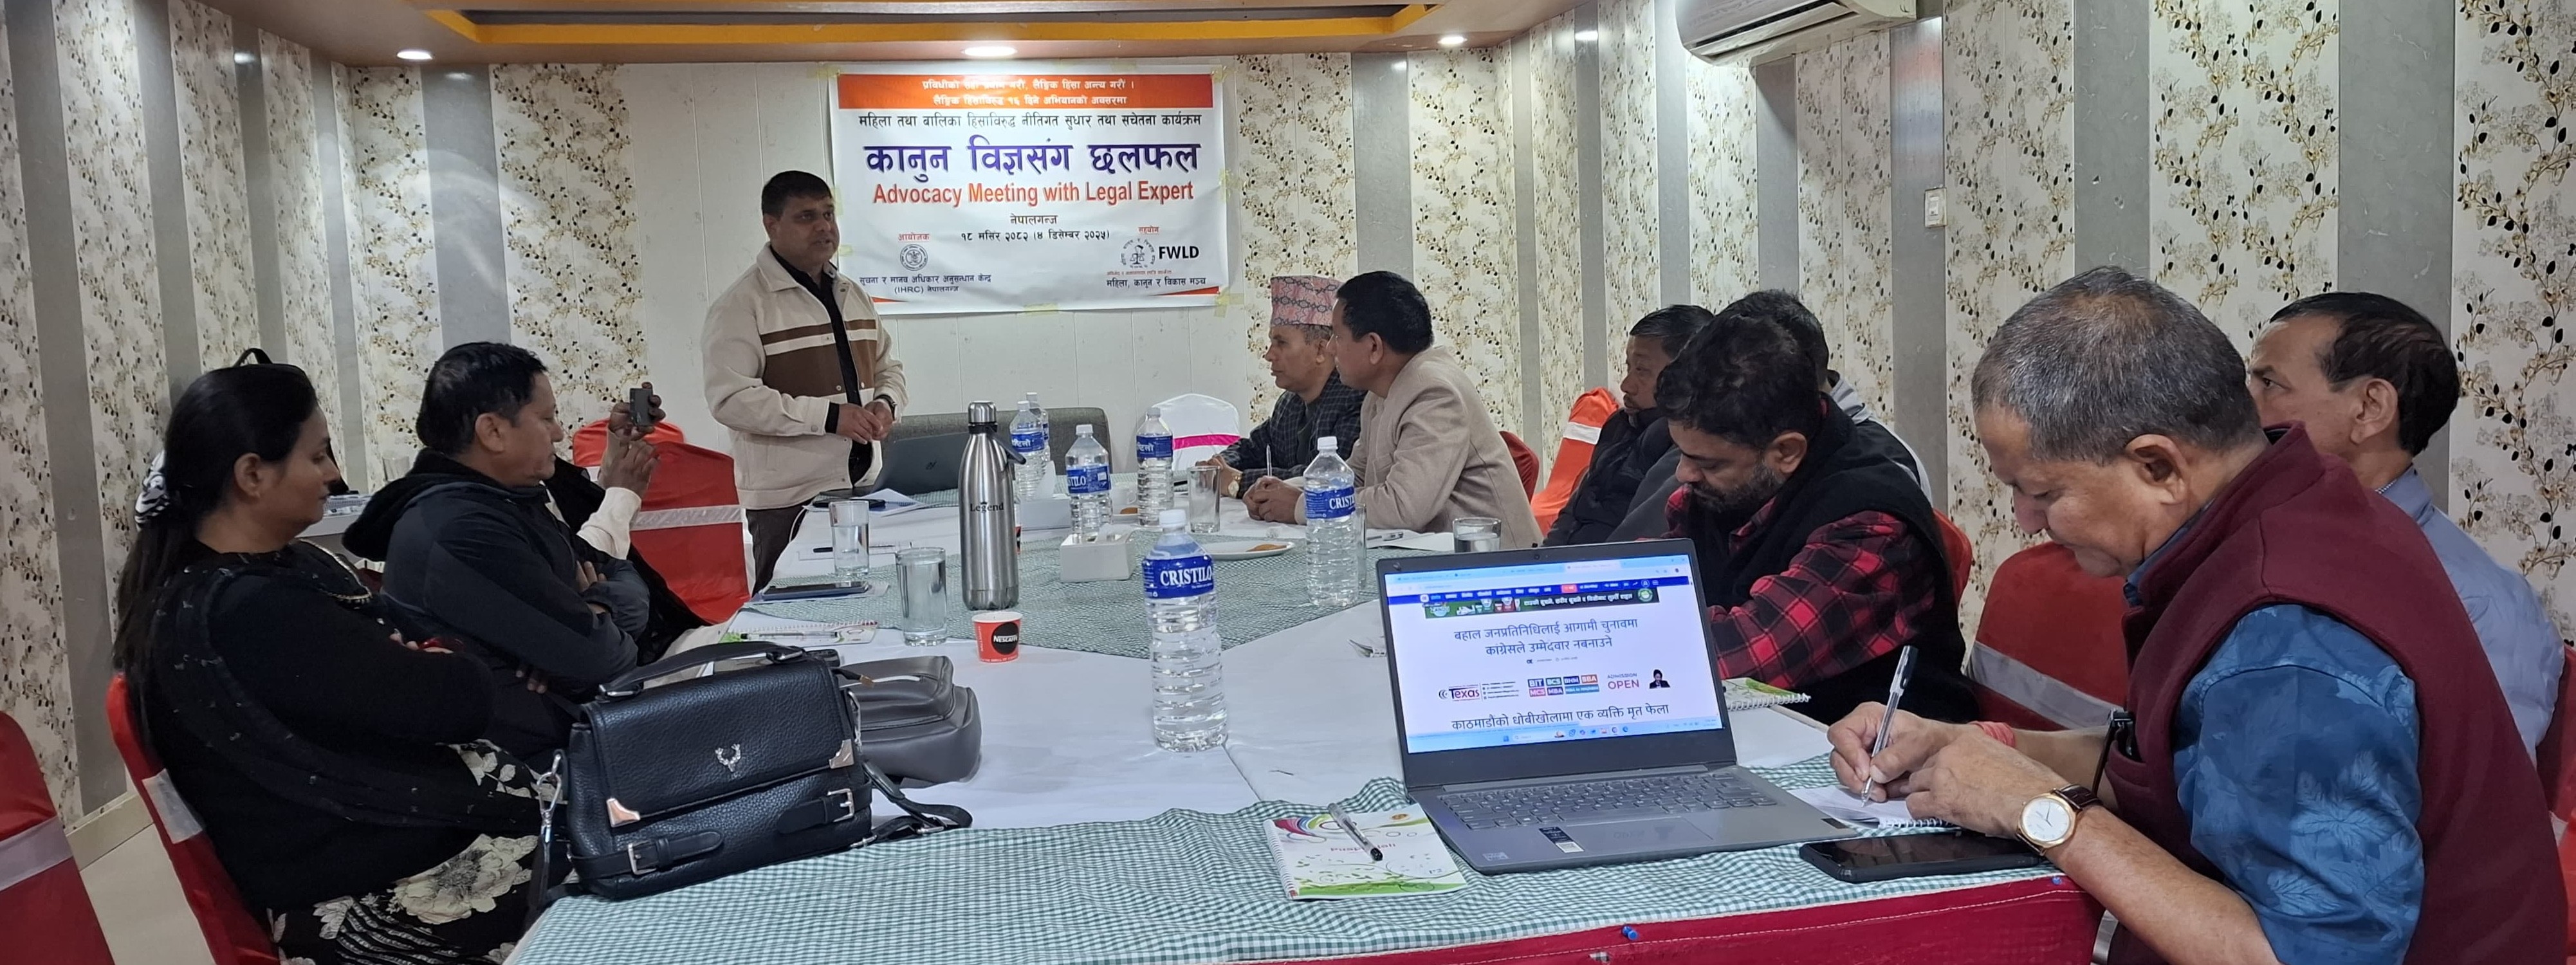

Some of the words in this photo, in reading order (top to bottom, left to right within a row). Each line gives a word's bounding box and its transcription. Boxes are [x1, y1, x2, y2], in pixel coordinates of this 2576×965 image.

[859, 112, 892, 129] महिला
[897, 116, 917, 127] तथा
[923, 112, 962, 128] बालिका
[1022, 111, 1059, 127] नीतिगत
[1065, 115, 1092, 130] सुधार
[1098, 115, 1116, 126] तथा
[1121, 112, 1156, 126] सचेतना
[1161, 111, 1202, 126] कार्यक्रम
[863, 146, 952, 183] कानुन
[966, 134, 1073, 175] विज्ञसंग
[1087, 143, 1201, 174] छलफल
[872, 183, 962, 208] Advocacy
[968, 183, 1038, 207] Meeting
[1043, 181, 1080, 202] with
[1086, 181, 1132, 205] Legal
[1138, 180, 1194, 205] Expert
[1010, 214, 1058, 225] नेपालगन्ज
[961, 232, 973, 241] १८
[1005, 232, 1028, 242] २०८२
[1159, 245, 1200, 260] FWLD
[912, 273, 939, 283] अधिकार
[1157, 278, 1161, 287] र
[1164, 276, 1186, 286] विकास
[894, 286, 924, 295] (IHRC)
[970, 502, 1004, 513] Legend
[1160, 565, 1212, 586] CRISTILO
[1484, 621, 1560, 638] जनप्रतिनिधिलाई
[1563, 618, 1597, 633] आगामी
[1601, 619, 1638, 634] चुनावमा
[1528, 639, 1570, 652] उम्मेदवार
[1572, 635, 1612, 648] नबनाउने
[1608, 679, 1640, 690] OPEN
[1449, 686, 1480, 699] Texas
[1513, 710, 1573, 725] धोबीखोलामा
[1576, 710, 1594, 720] एक
[1597, 705, 1624, 719] व्यक्ति
[1627, 707, 1642, 719] मृत
[1645, 703, 1669, 715] फेला
